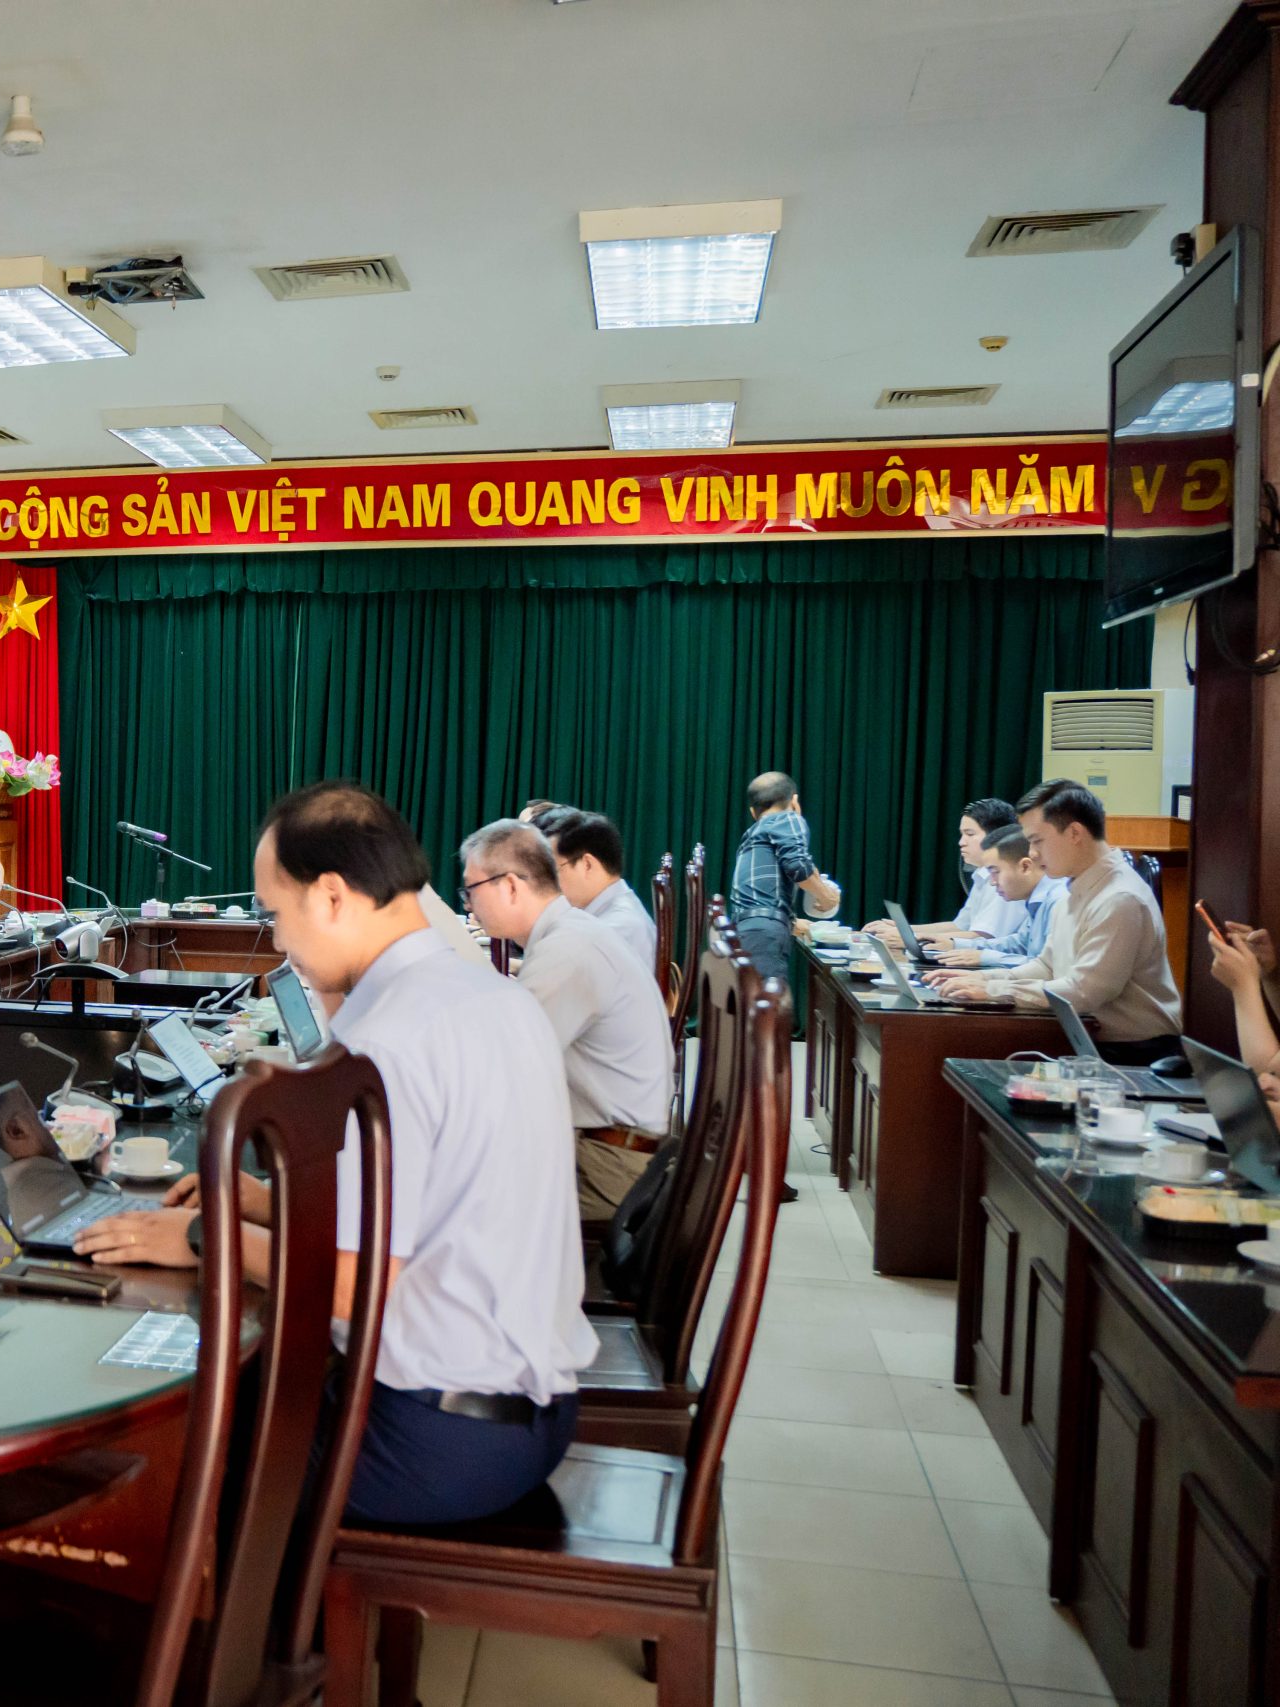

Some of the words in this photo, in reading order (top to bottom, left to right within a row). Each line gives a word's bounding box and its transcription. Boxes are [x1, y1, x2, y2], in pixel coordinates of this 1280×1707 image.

[121, 476, 212, 536] SẢN
[226, 476, 327, 541] VIỆT
[343, 483, 452, 530] NAM
[468, 476, 642, 526] QUANG
[659, 473, 779, 522] VINH
[794, 455, 952, 518] MUÔN
[969, 453, 1095, 514] NĂM
